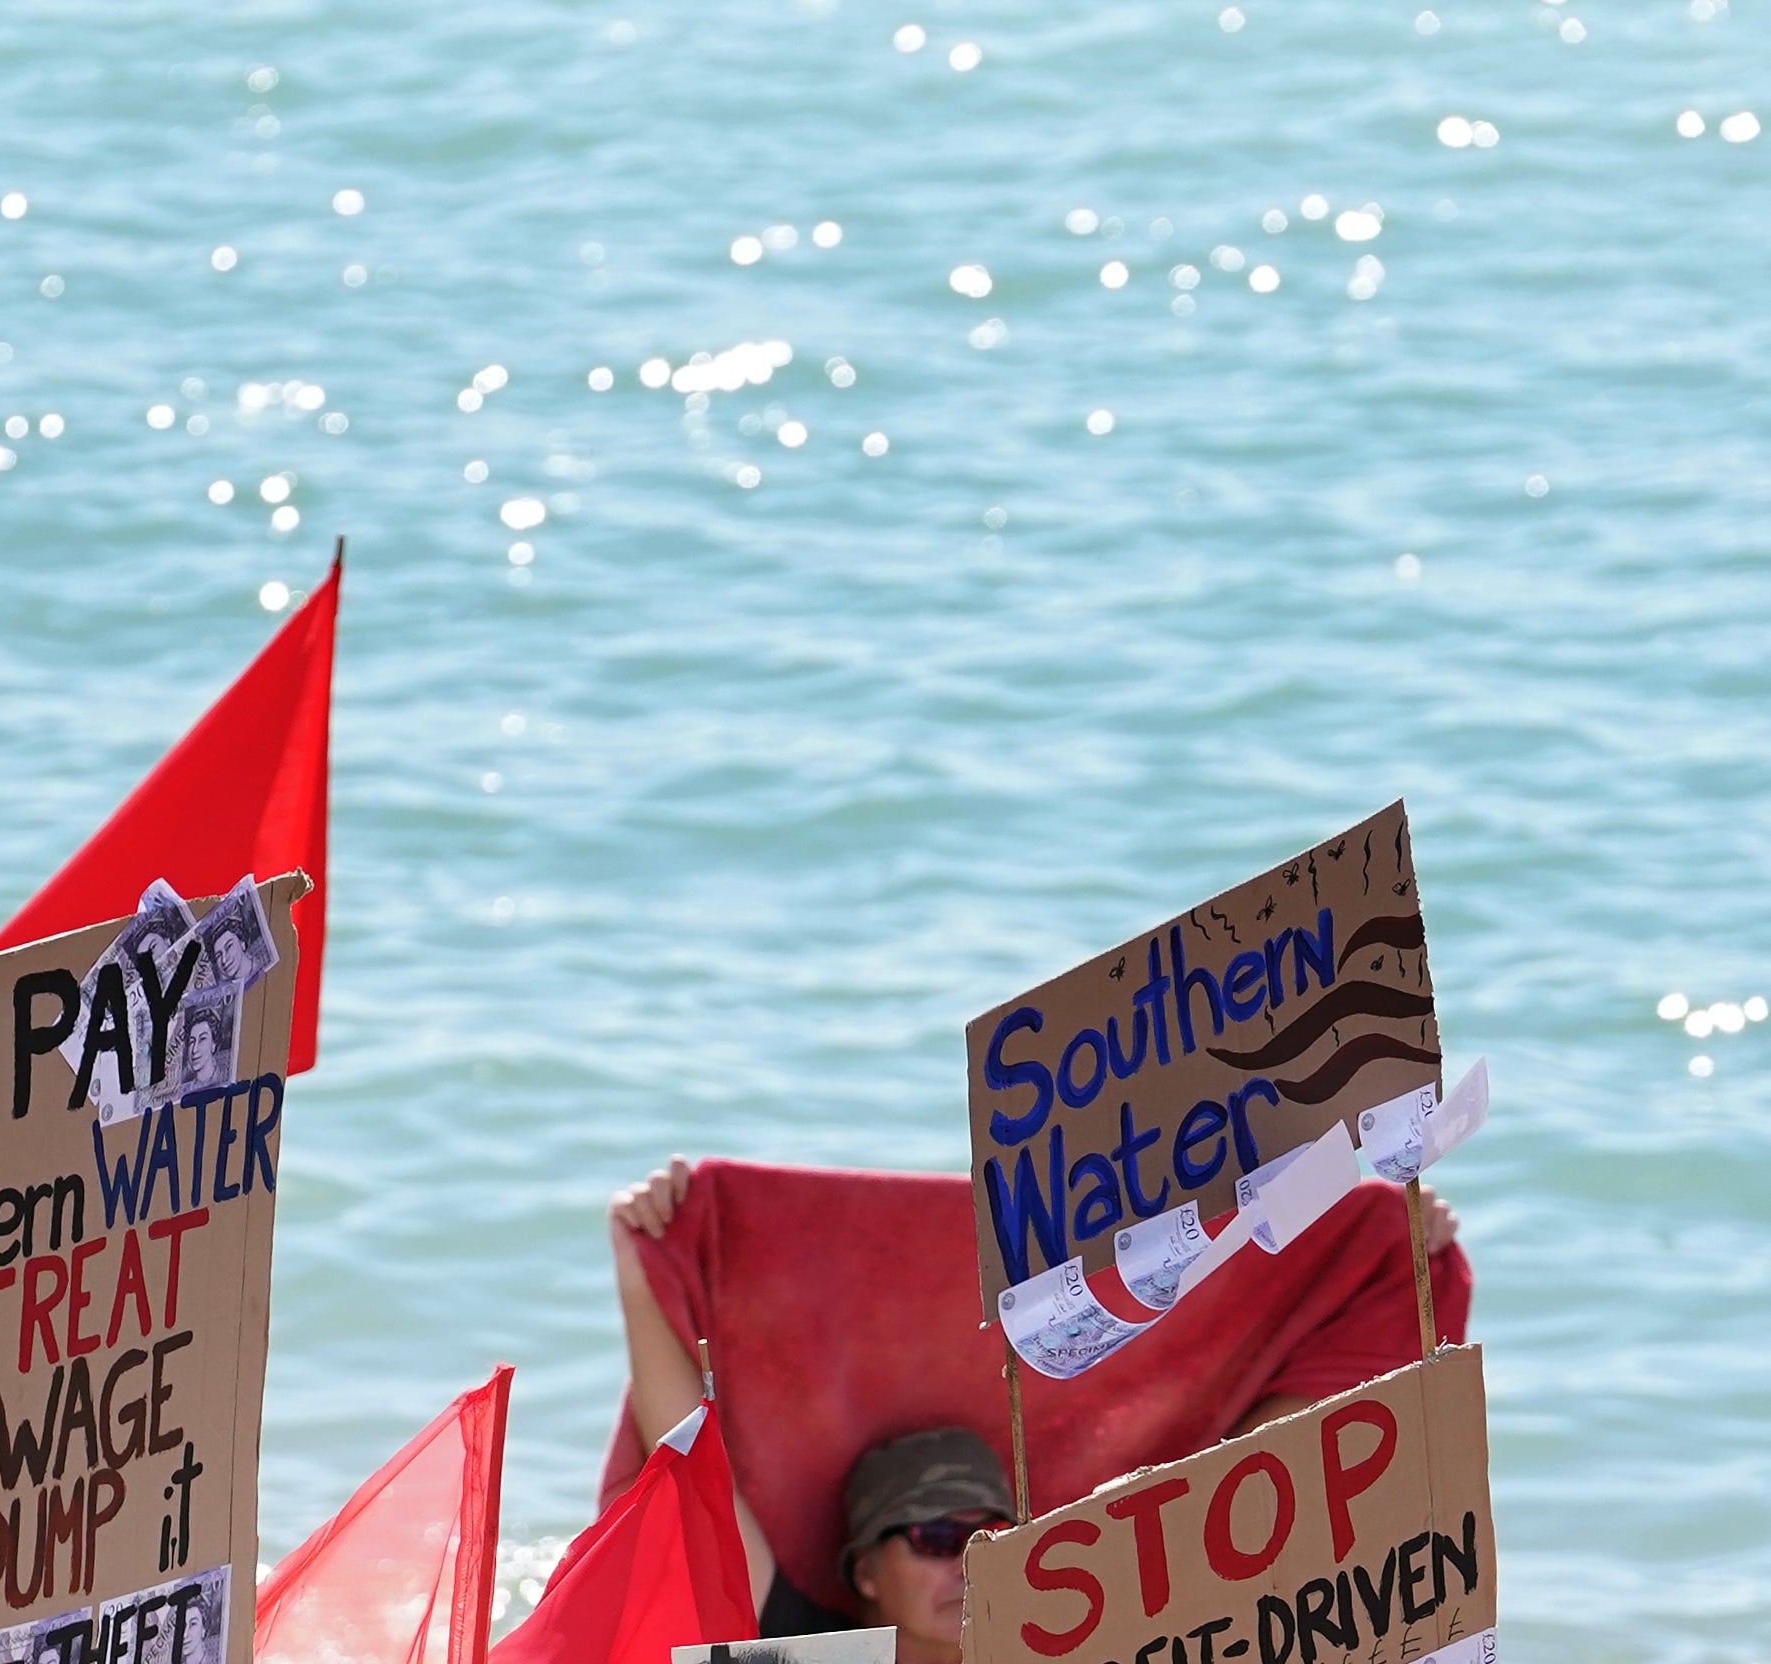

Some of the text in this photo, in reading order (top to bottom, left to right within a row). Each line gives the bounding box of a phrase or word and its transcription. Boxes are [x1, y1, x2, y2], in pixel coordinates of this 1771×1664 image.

[12, 940, 201, 1119] PAY
[92, 1072, 284, 1229] WATER
[984, 1076, 1279, 1286] Water
[160, 1442, 202, 1573] it
[1021, 1400, 1396, 1657] STOP
